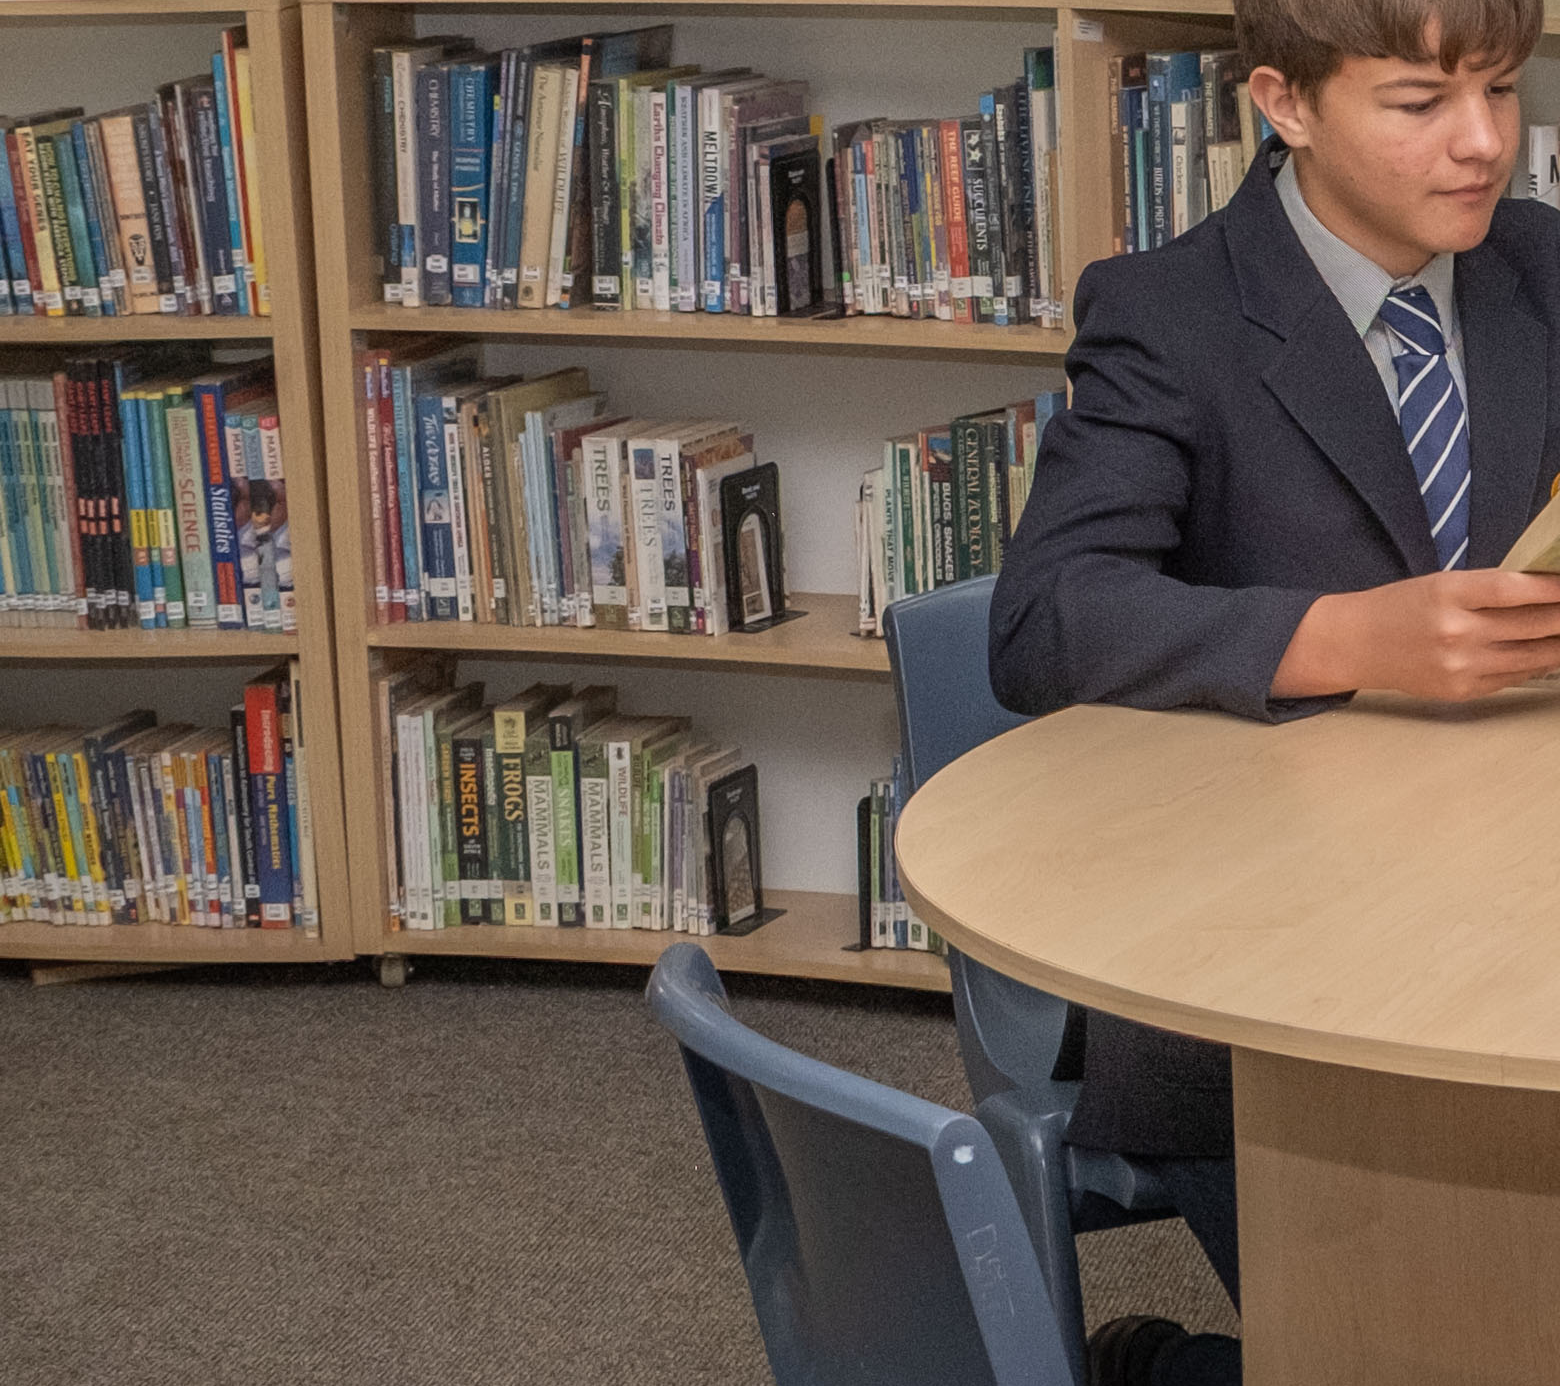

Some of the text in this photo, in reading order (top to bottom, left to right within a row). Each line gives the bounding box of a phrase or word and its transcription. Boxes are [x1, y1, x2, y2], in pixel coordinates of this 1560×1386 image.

[429, 79, 441, 138] CHEMISTRY
[465, 77, 477, 143] CHEMISTRY
[703, 130, 719, 204] MELTDOWN
[947, 129, 962, 222] THE REEF GUIDE
[972, 178, 988, 250] SUCCULENTS
[232, 433, 244, 475] MATHS
[266, 434, 278, 478] MATHS
[593, 445, 611, 512] TREES
[661, 453, 676, 512] TREES
[179, 477, 201, 553] SCIENCE
[210, 486, 232, 553] Statistics
[639, 487, 658, 548] TREES
[941, 481, 954, 581] BUGS, SNAKES
[964, 428, 984, 568] GENERAL ZOOLOGY
[884, 489, 895, 583] PLANTS THAT MOVE
[459, 762, 479, 837] INSECTS
[502, 757, 524, 822] FROGS
[558, 787, 573, 847] SNAKES
[617, 766, 628, 818] WILDLIFE
[268, 804, 282, 870] Mathematics
[534, 779, 550, 870] MAMMALS
[587, 782, 604, 872] MAMMALS
